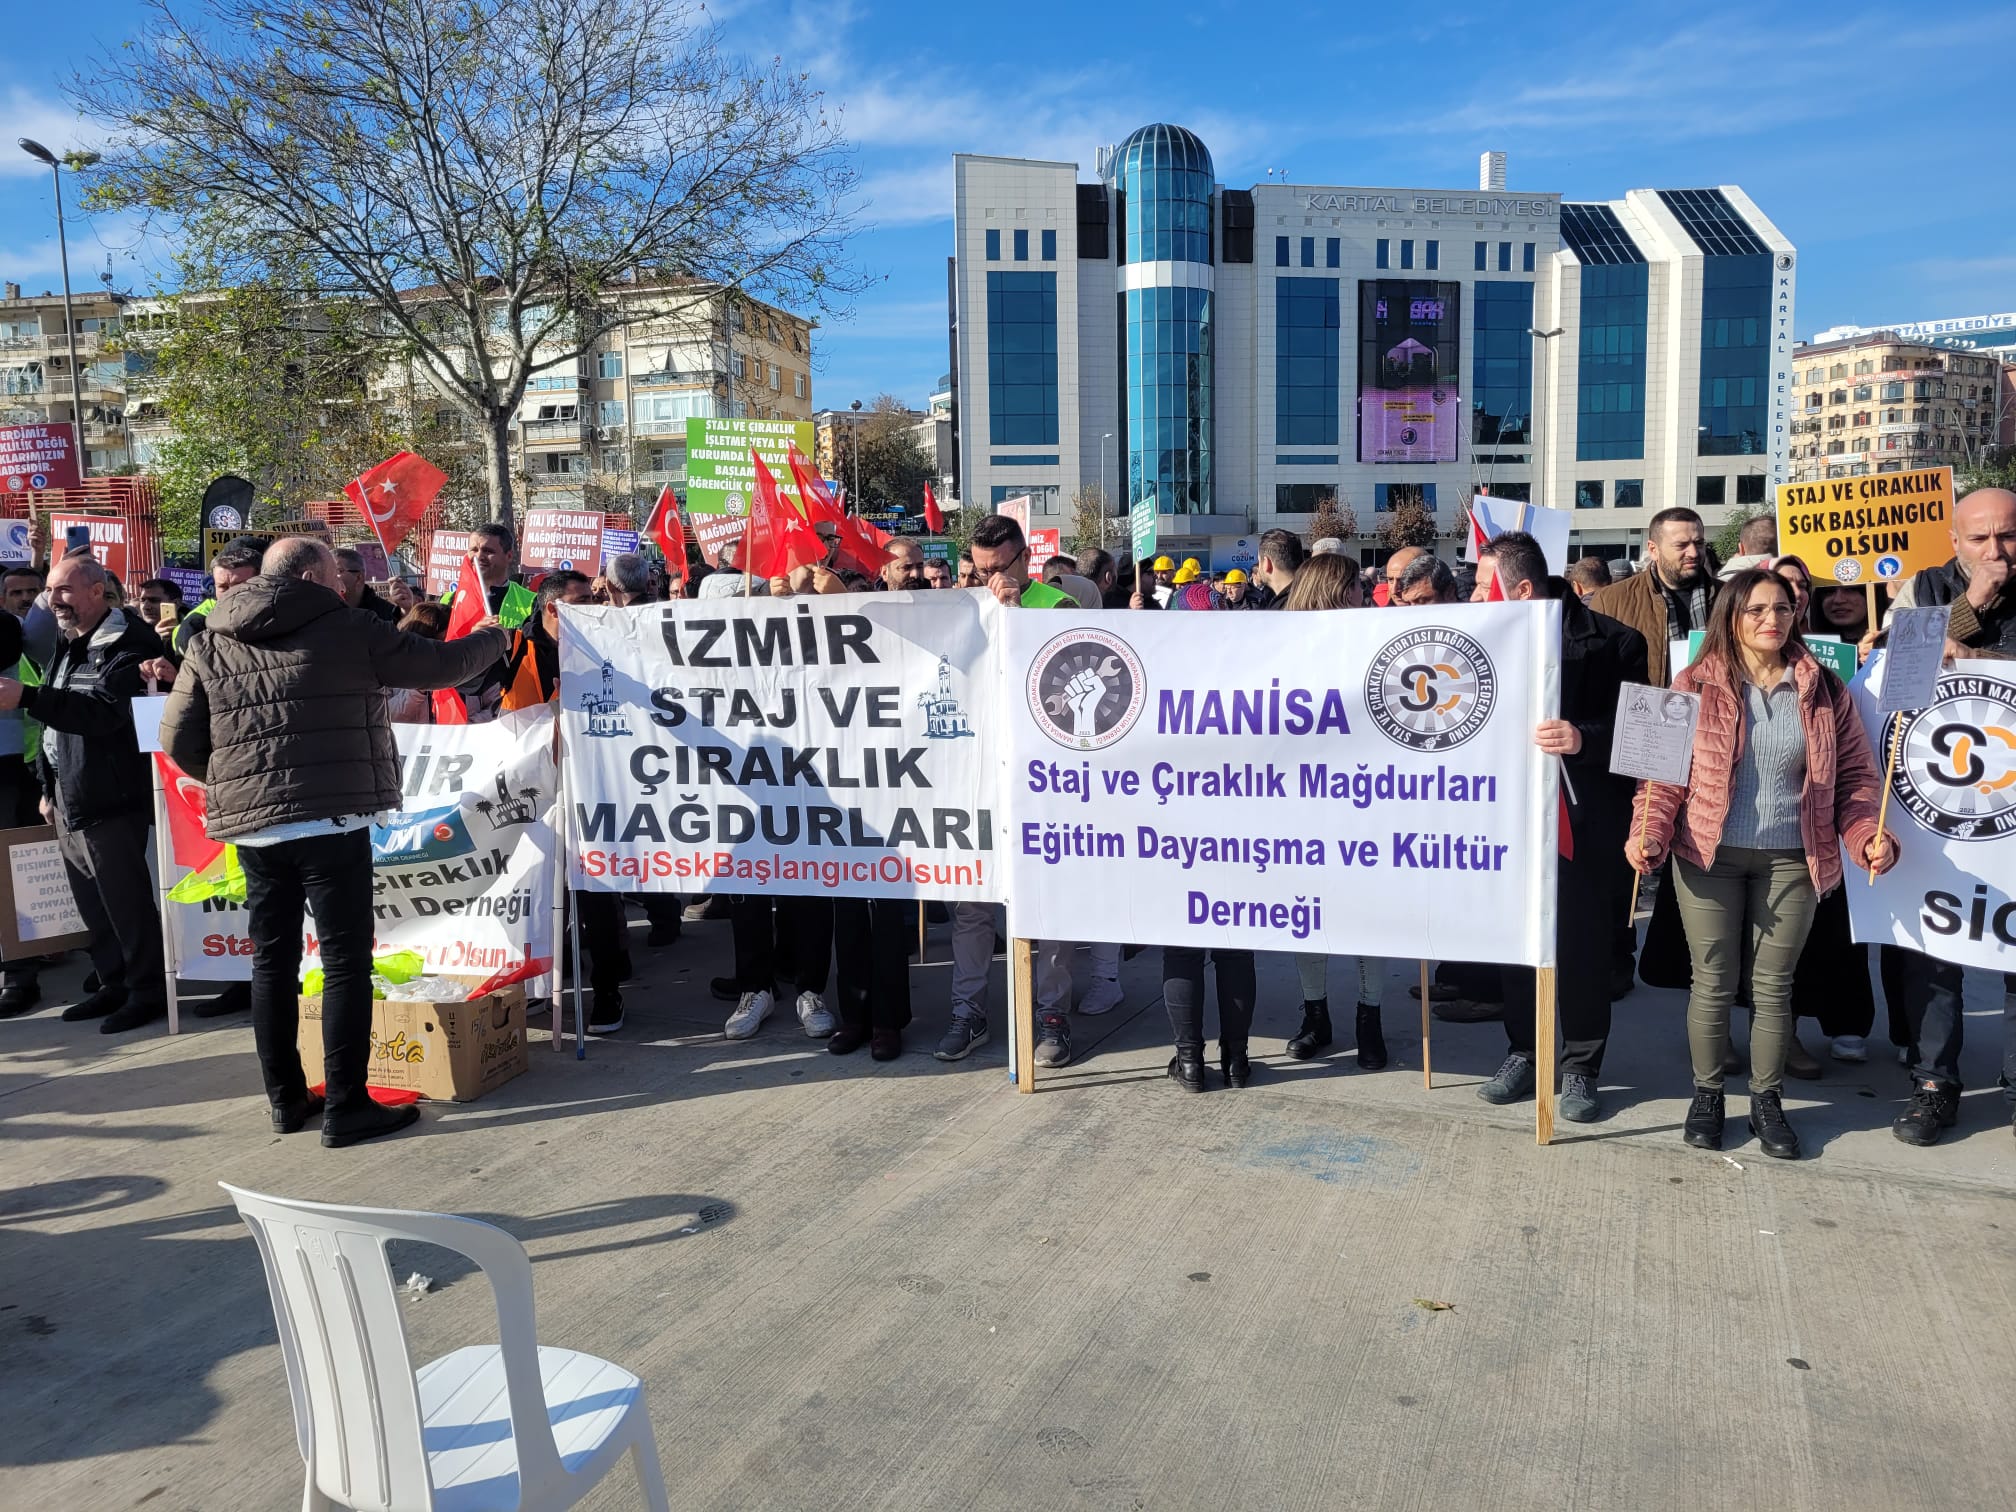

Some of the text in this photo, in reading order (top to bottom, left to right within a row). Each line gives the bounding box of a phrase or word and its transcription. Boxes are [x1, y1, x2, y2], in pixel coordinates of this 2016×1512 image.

[1304, 194, 1553, 217] KARTAL BELEDİYESİ
[1774, 278, 1788, 484] KARTAL BELEDİYES
[0, 426, 48, 440] ERDİMİZ
[705, 420, 796, 435] STAJ VE ÇIRAKLIK
[705, 432, 747, 447] İŞLETME
[749, 437, 775, 448] VEYA
[0, 436, 69, 452] KLİLİK DEĞİL
[691, 449, 745, 462] KURUMDA
[0, 450, 65, 464] KLARIMIZIN
[0, 461, 55, 476] ADESİDİR.
[688, 475, 743, 491] ÖĞRENCİLİK
[1787, 473, 1942, 506] STAJ VE ÇIRAKLIK
[53, 520, 75, 539] HA
[529, 514, 598, 531] STAJ VE ÇIRAKLIK
[700, 517, 747, 541] MAĞDURİY
[1789, 501, 1944, 535] SGK BAŞLANGICI
[527, 530, 598, 546] MAĞDURİYETİNE
[1826, 531, 1909, 557] OLSUN
[0, 550, 23, 558] SUN
[530, 545, 591, 560] SON VERİLSİN!
[661, 604, 881, 667] İZMİR
[1806, 642, 1835, 656] 4-15
[1369, 630, 1492, 743] STAJ VE ÇIRAKLIK SİGORTASI MAĞDURLARI FEDERASYONU
[650, 686, 902, 729] STAJ VE
[1157, 678, 1351, 735] MANİSA
[399, 745, 474, 796] İR
[630, 745, 933, 796] ÇIRAKLIK
[1028, 759, 1496, 809] Staj ve Çıraklık Mağdurları
[1906, 793, 1939, 824] STAJ
[577, 794, 993, 851] MAĞDURLARI
[1022, 822, 1508, 873] Eğitim Dayanışma ve Kültür
[410, 888, 531, 924] Derneği
[1188, 891, 1321, 939] Derneği
